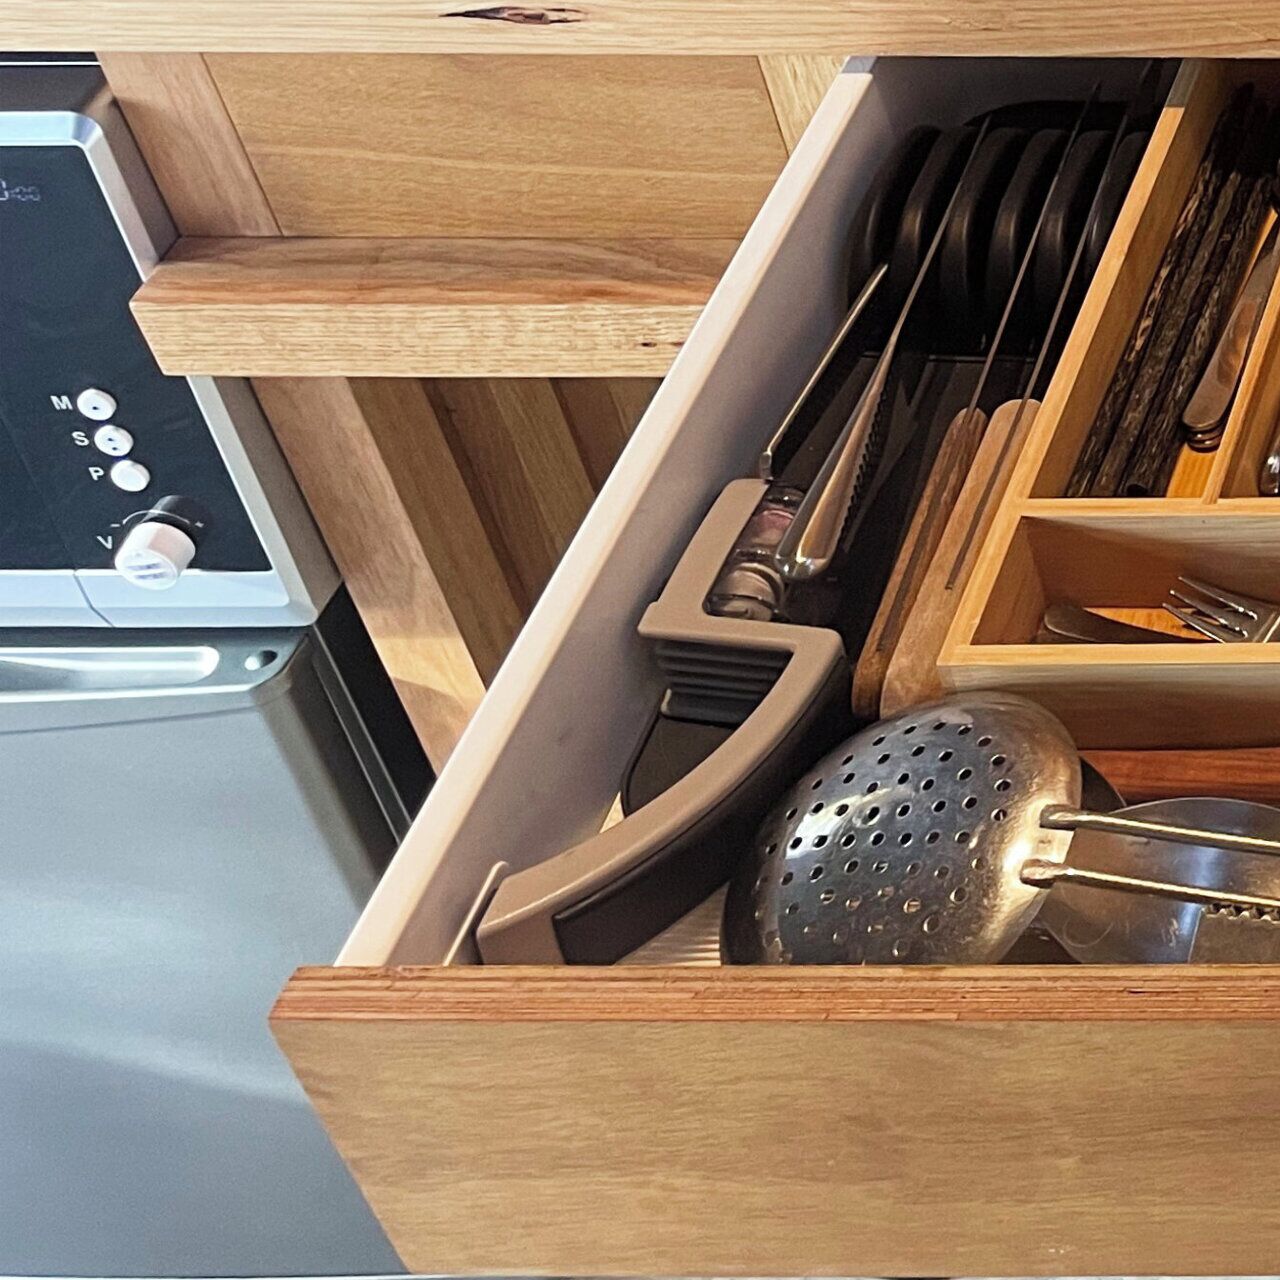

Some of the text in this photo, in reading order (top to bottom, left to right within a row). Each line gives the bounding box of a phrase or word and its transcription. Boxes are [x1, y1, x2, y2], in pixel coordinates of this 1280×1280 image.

[50, 395, 73, 410] M
[72, 431, 90, 446] S
[89, 467, 104, 480] P
[97, 536, 113, 549] V
